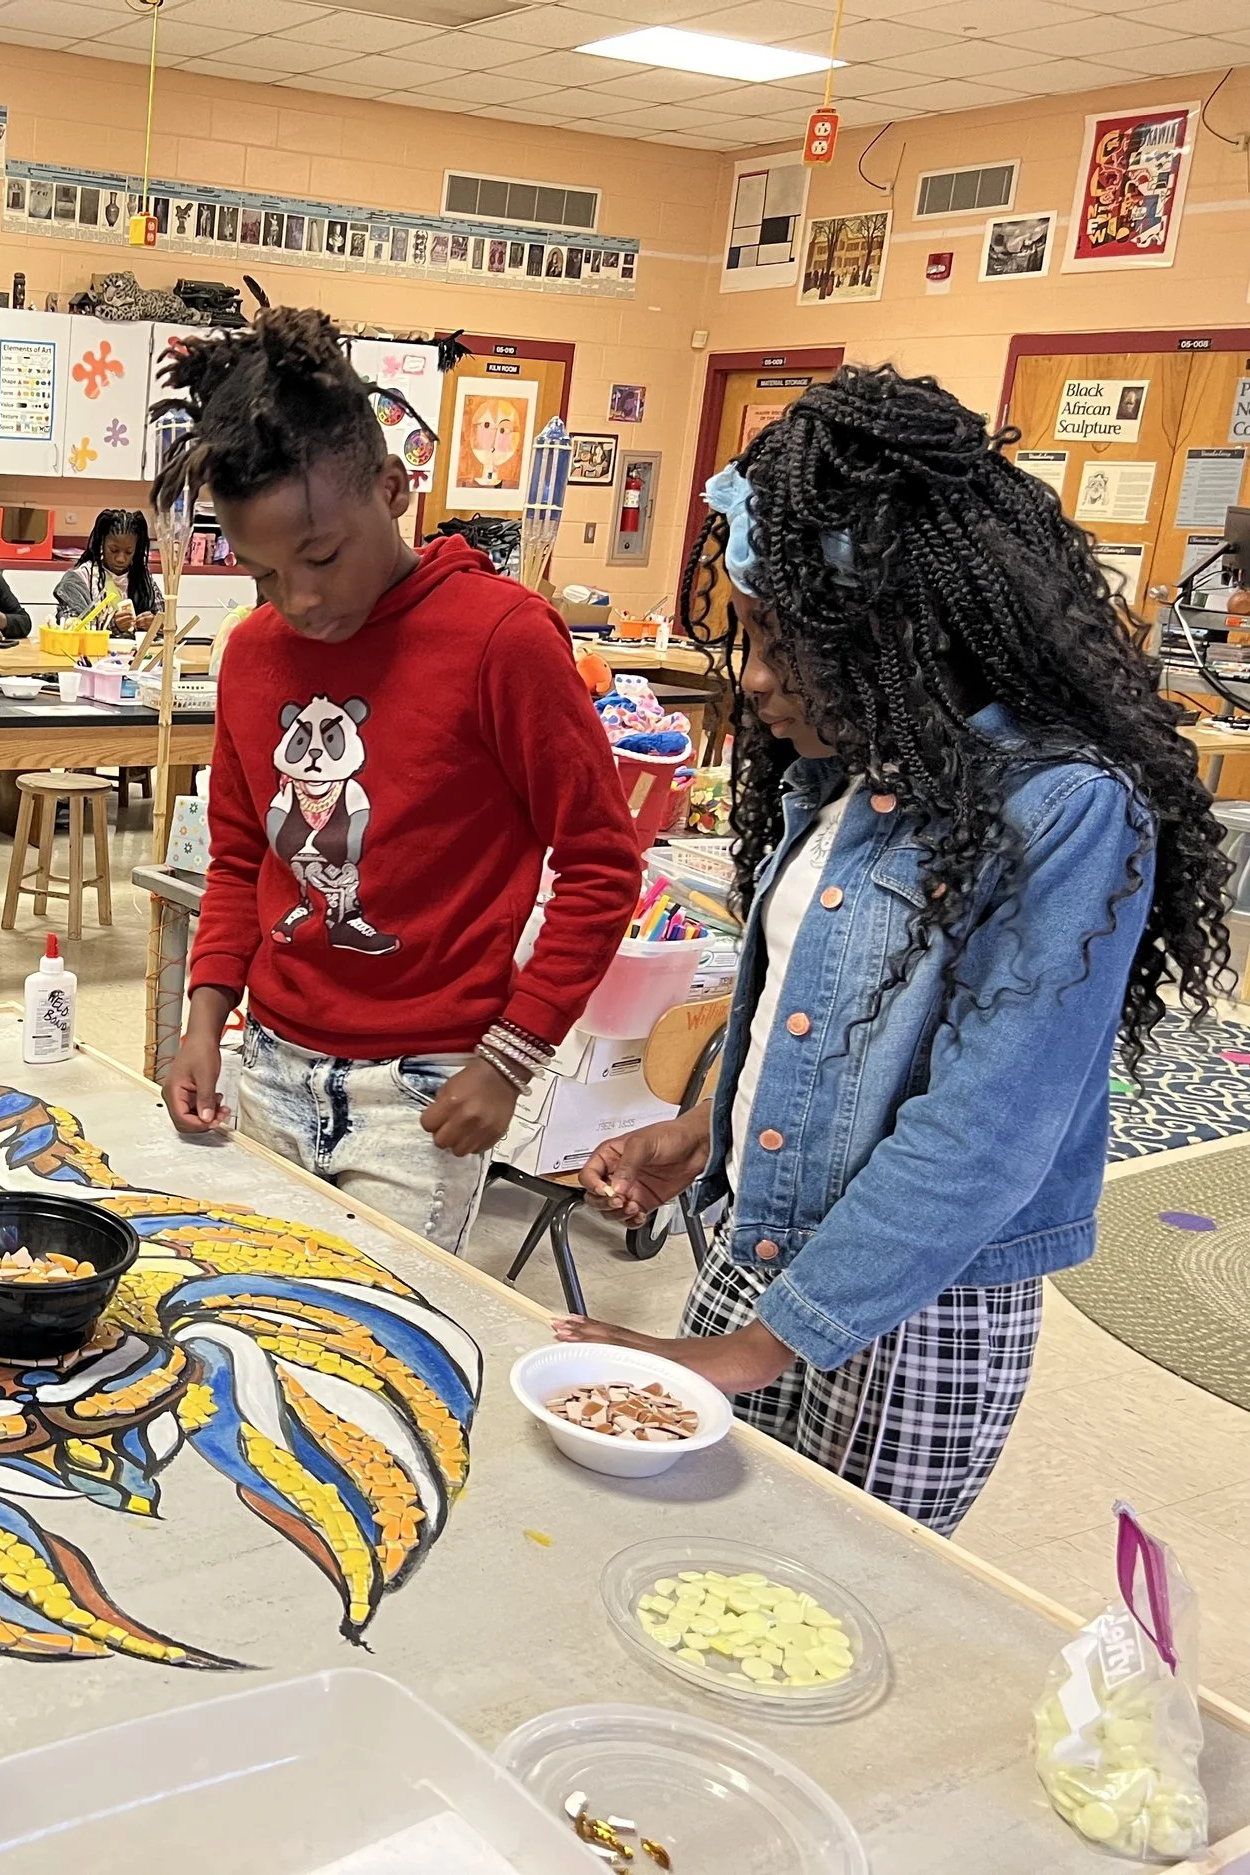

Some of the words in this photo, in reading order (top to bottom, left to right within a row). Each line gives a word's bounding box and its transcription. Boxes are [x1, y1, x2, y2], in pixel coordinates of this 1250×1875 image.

[3, 344, 32, 352] Elements
[1180, 340, 1209, 348] 05-008
[1066, 383, 1104, 397] Black
[1061, 401, 1111, 417] African
[1057, 419, 1122, 438] Sculpture
